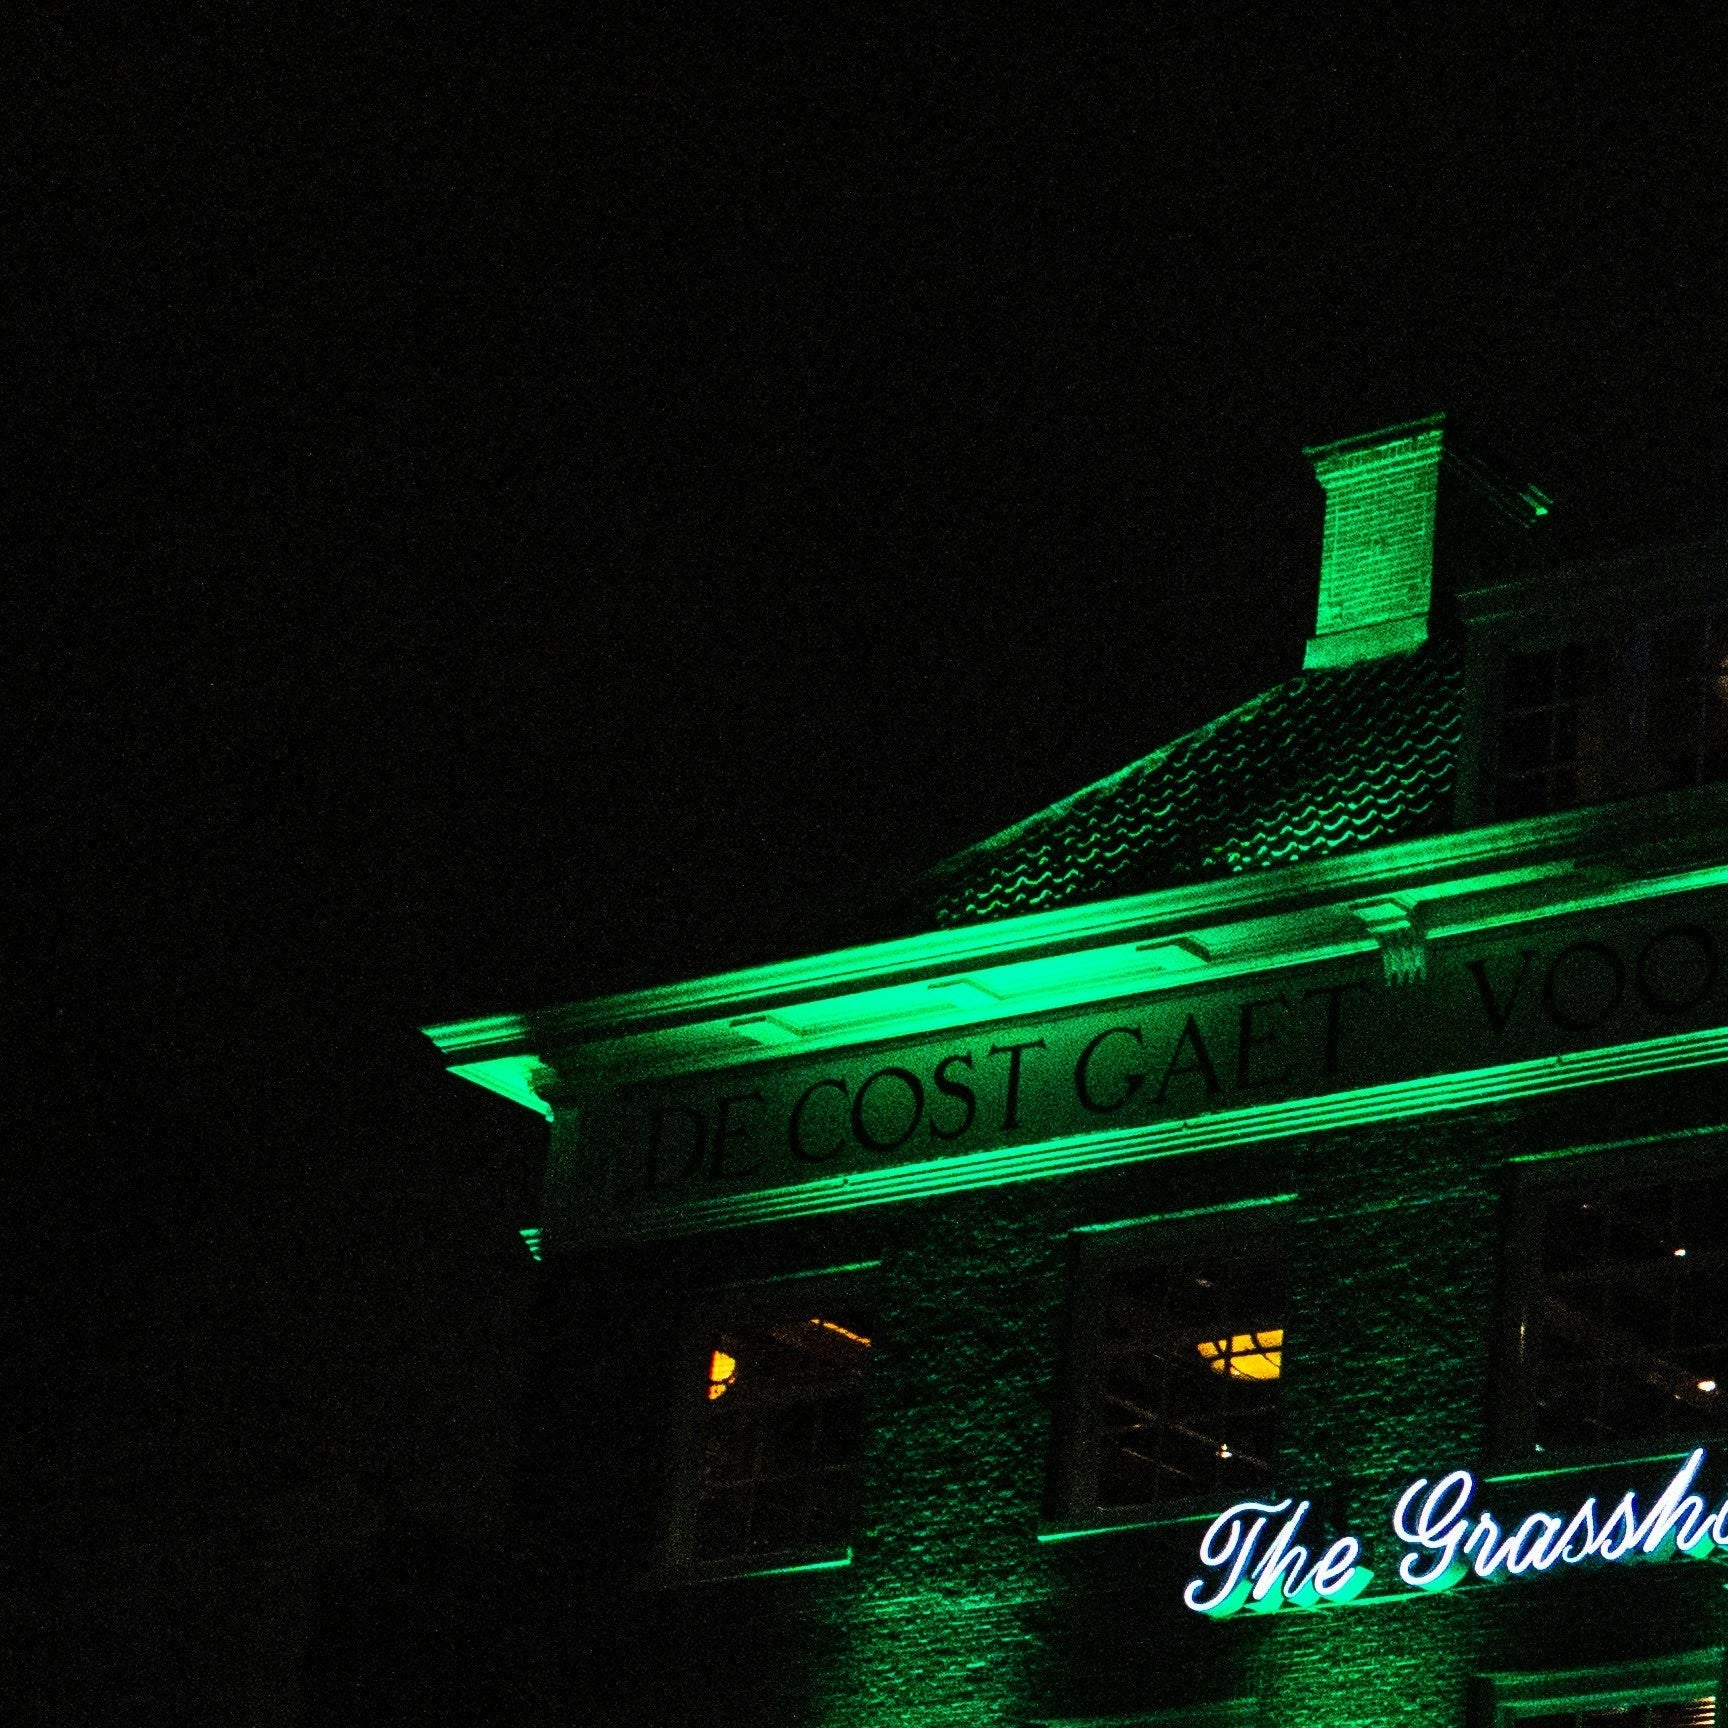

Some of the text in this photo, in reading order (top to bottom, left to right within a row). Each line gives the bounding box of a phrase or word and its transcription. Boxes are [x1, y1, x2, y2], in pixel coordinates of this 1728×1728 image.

[640, 1089, 770, 1191] DE
[789, 1038, 1046, 1161] COST
[1075, 978, 1372, 1112] GAET
[1184, 1500, 1360, 1613] The
